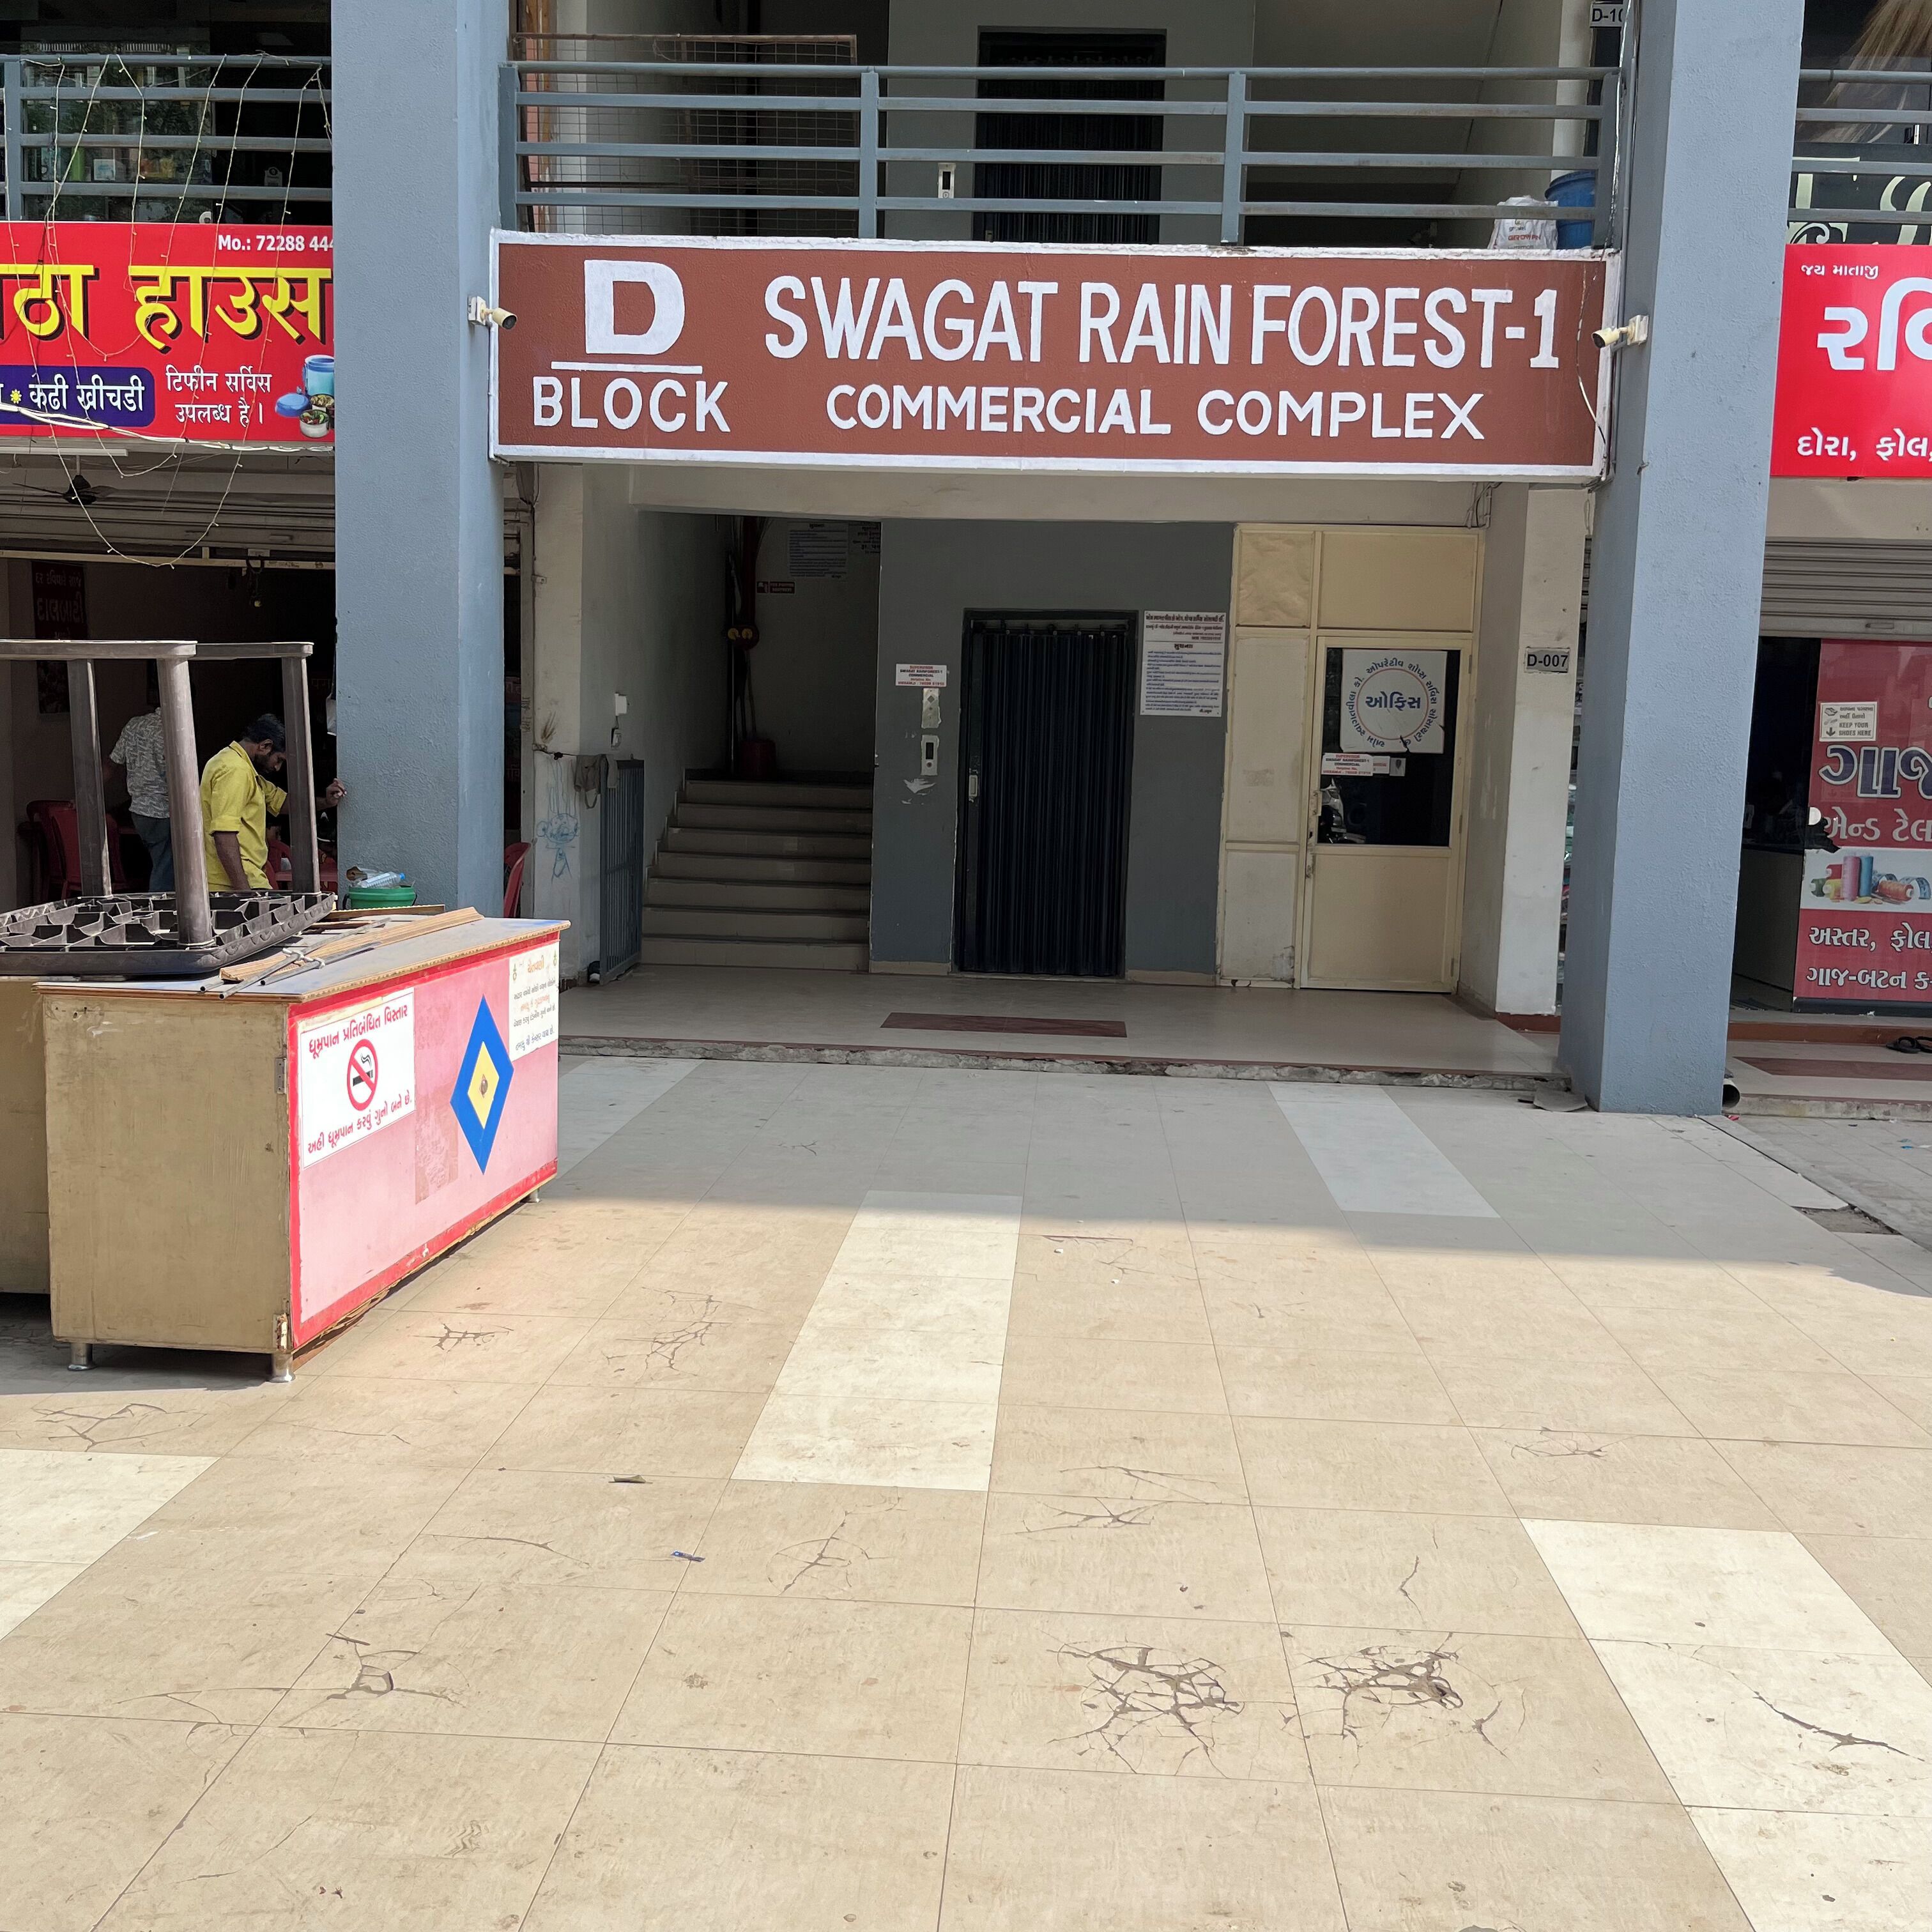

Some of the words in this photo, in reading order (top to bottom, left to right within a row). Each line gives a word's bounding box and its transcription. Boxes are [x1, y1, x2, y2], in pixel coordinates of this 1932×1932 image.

[218, 234, 251, 251] Mo.:
[256, 234, 305, 252] 72288
[1800, 265, 1825, 276] જય
[1832, 265, 1880, 280] માતાજી
[0, 264, 95, 337] ठा
[128, 266, 332, 351] हाउस
[584, 259, 685, 355] D
[764, 275, 1059, 363] SWAGAT
[1078, 281, 1232, 365] RAIN
[1250, 284, 1560, 369] FOREST-1
[76, 374, 145, 412] खीचडी
[165, 364, 219, 392] टिफीन
[224, 365, 273, 394] सर्विस
[174, 403, 233, 424] उपलब्ध
[238, 396, 250, 428] है
[533, 376, 731, 433] BLOCK
[826, 384, 1171, 435] COMMERCIAL
[1196, 389, 1485, 440] COMPLEX
[1797, 427, 1857, 462] દોરા,
[1366, 657, 1404, 674] ઓપરેટીવ
[1527, 654, 1568, 667] D-007
[1365, 691, 1421, 712] ઓફિસ
[1809, 926, 1876, 952] અસ્તર,
[1890, 921, 1932, 952] ફોલ
[1806, 967, 1908, 989] ગાજ-બટન
[1913, 970, 1932, 990] ક
[342, 1013, 381, 1041] પ્રતિબંધિત
[384, 1004, 408, 1025] વિસ્તાર
[356, 1109, 372, 1130] કરવું
[374, 1100, 388, 1126] ગુનો
[390, 1093, 402, 1113] બને
